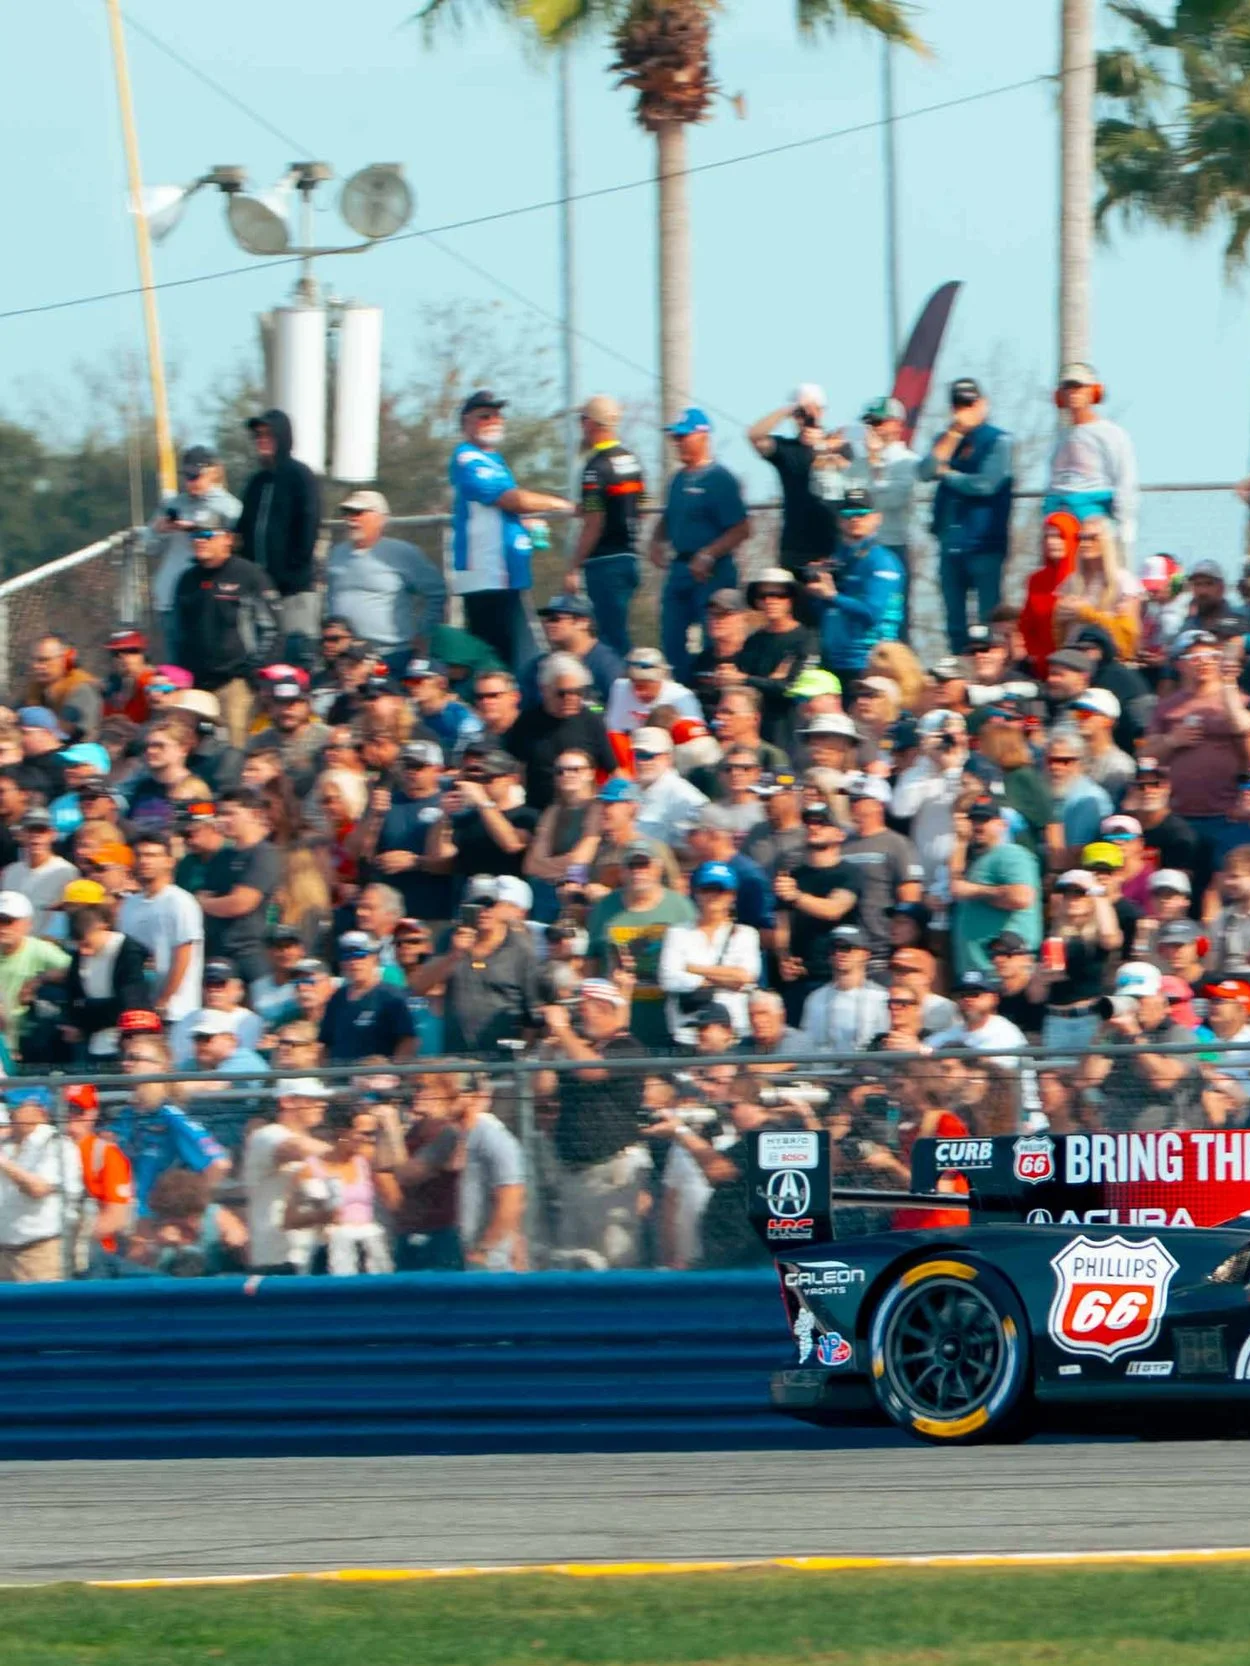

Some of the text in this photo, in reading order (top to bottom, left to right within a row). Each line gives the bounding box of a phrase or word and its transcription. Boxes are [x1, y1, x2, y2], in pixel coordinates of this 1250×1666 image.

[935, 1141, 994, 1162] CURB
[1065, 1132, 1184, 1184] BRING
[1021, 1156, 1047, 1173] 66
[1073, 1256, 1158, 1278] PHILLIPS
[785, 1269, 866, 1287] GALEON
[803, 1286, 846, 1296] YACHTS
[1071, 1290, 1148, 1333] 66
